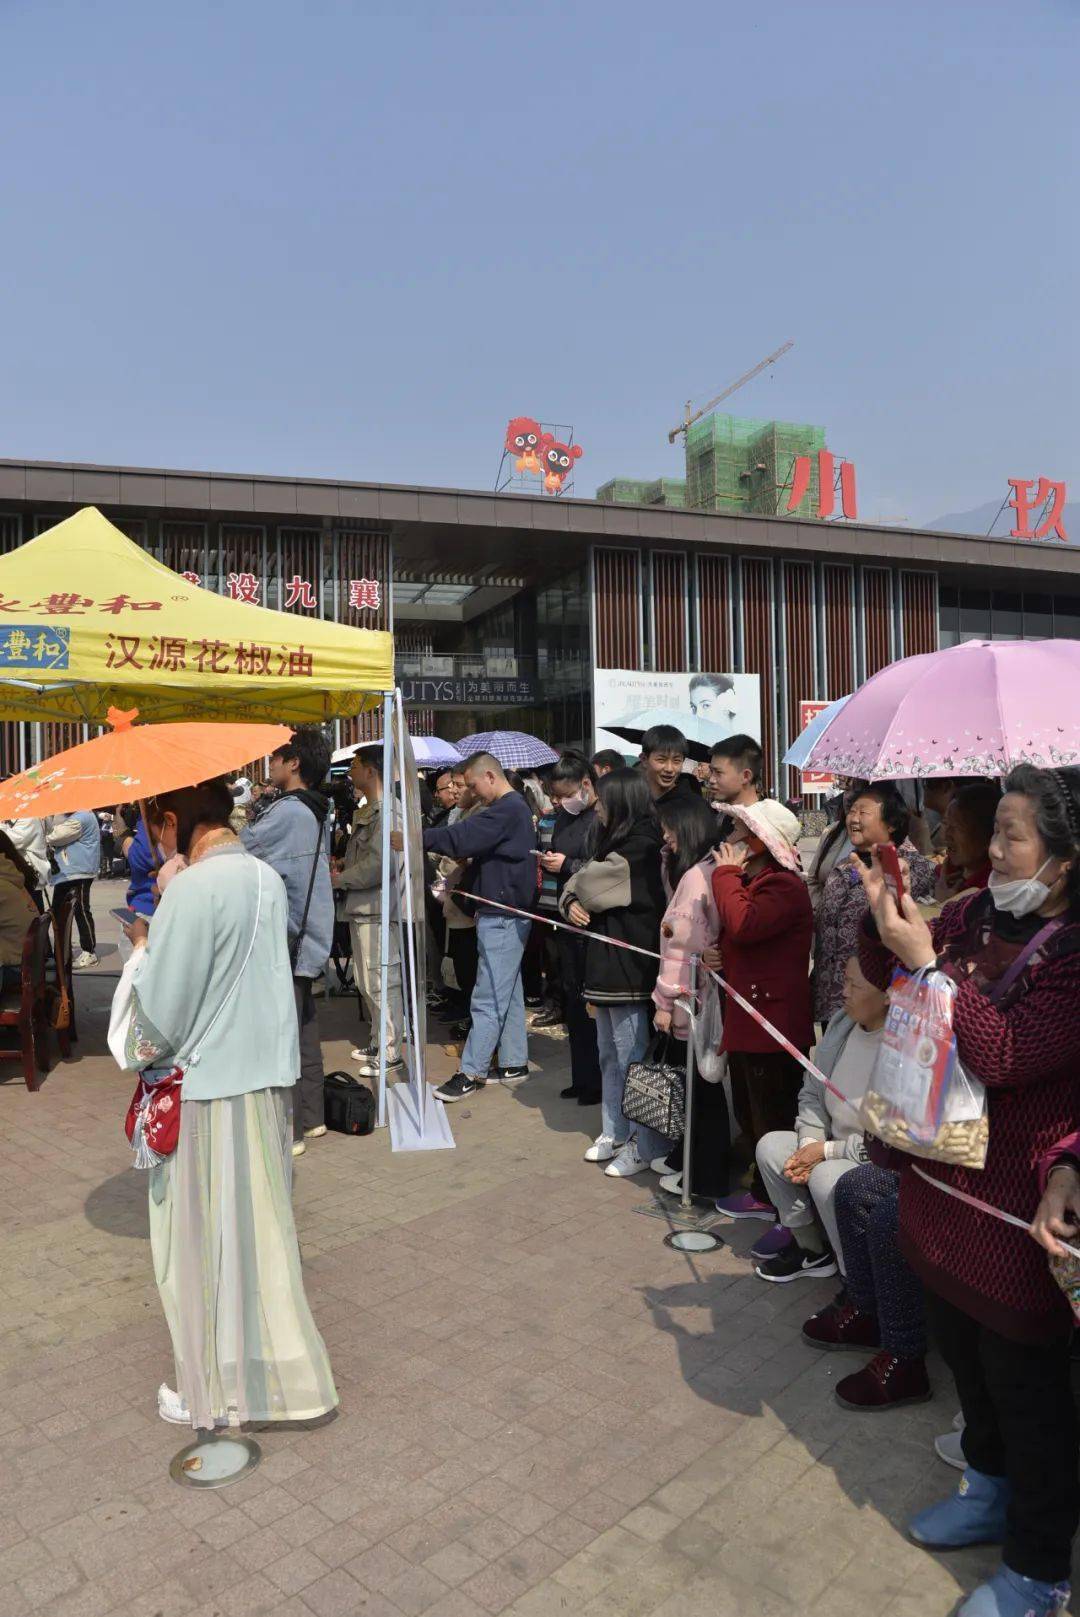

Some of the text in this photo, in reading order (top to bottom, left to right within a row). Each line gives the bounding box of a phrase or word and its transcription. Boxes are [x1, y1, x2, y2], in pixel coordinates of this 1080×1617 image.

[105, 633, 313, 677] 汉源花椒油
